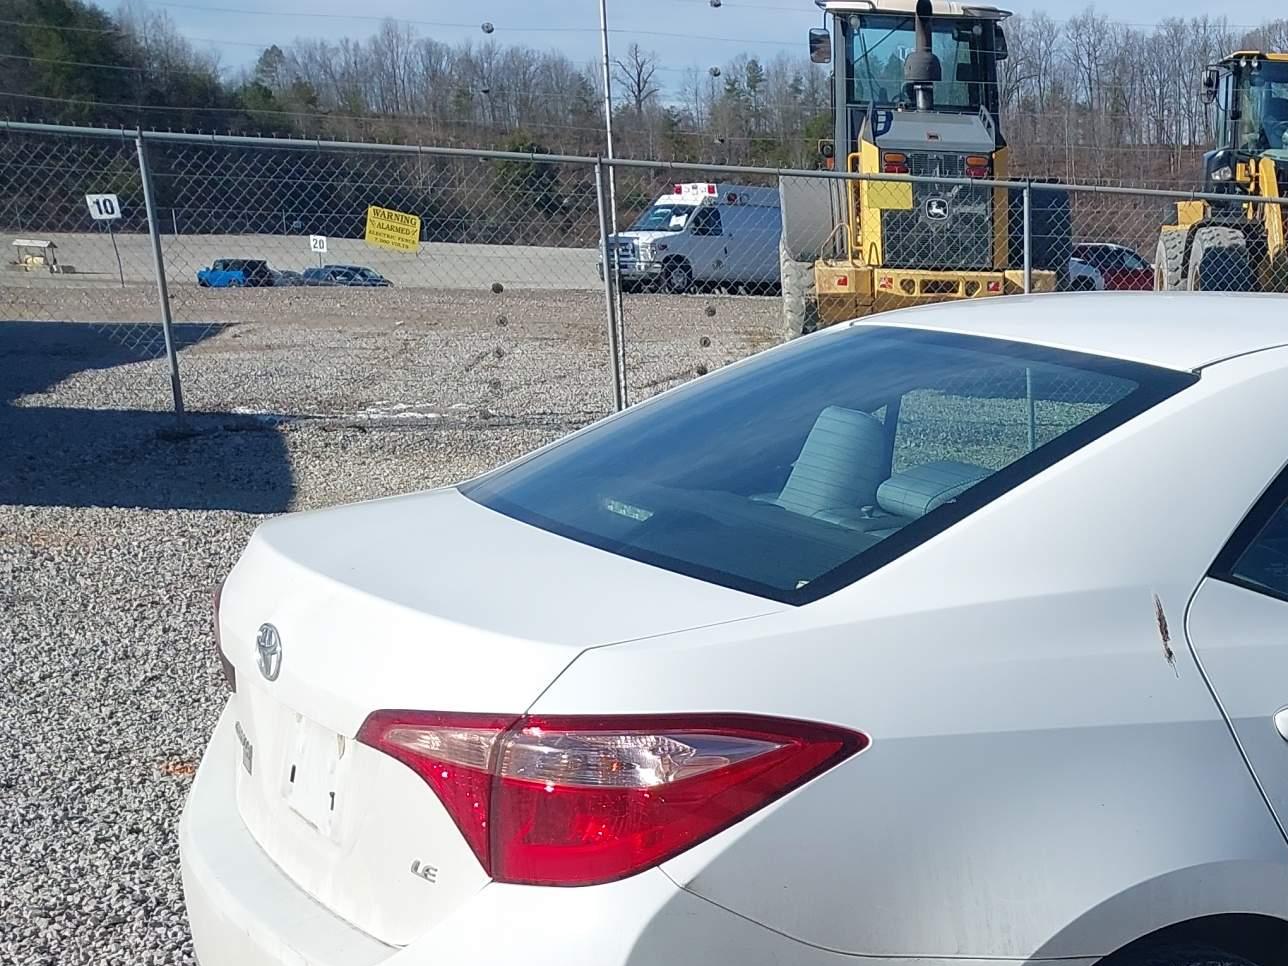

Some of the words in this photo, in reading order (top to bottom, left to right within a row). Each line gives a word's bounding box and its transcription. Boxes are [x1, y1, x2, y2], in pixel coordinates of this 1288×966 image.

[93, 198, 115, 215] 10
[372, 208, 417, 226] WARNING
[376, 222, 411, 236] ALARMED
[312, 238, 325, 249] 20
[410, 860, 438, 884] LE
